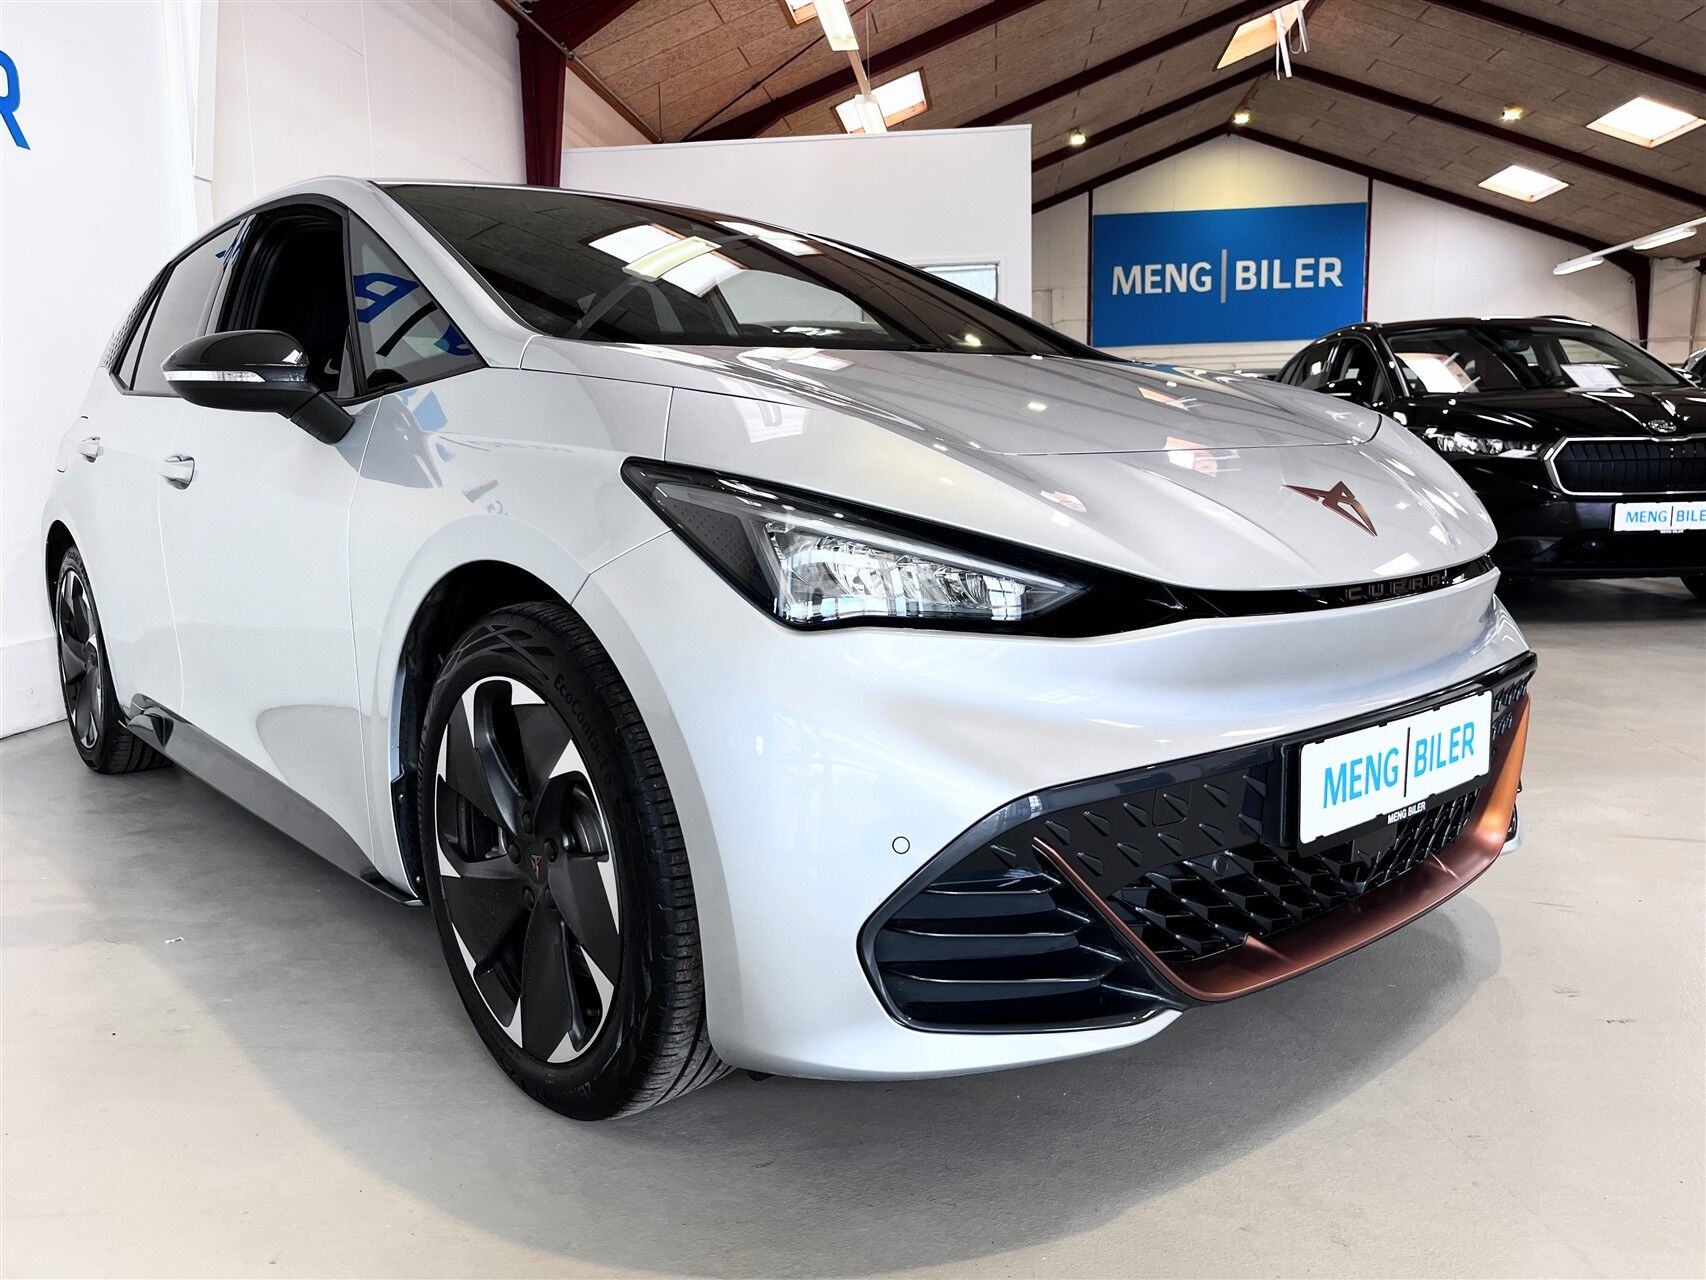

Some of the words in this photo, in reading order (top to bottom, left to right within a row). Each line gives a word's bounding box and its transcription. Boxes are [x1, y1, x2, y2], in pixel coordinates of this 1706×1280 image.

[1111, 261, 1212, 296] MENG
[1235, 256, 1344, 291] BILER
[1625, 510, 1668, 523] MENG
[554, 672, 609, 770] EcoContact
[1323, 747, 1399, 809] MENG
[1413, 721, 1475, 778] BILER
[1387, 808, 1407, 824] MENG
[1407, 801, 1426, 817] BILER
